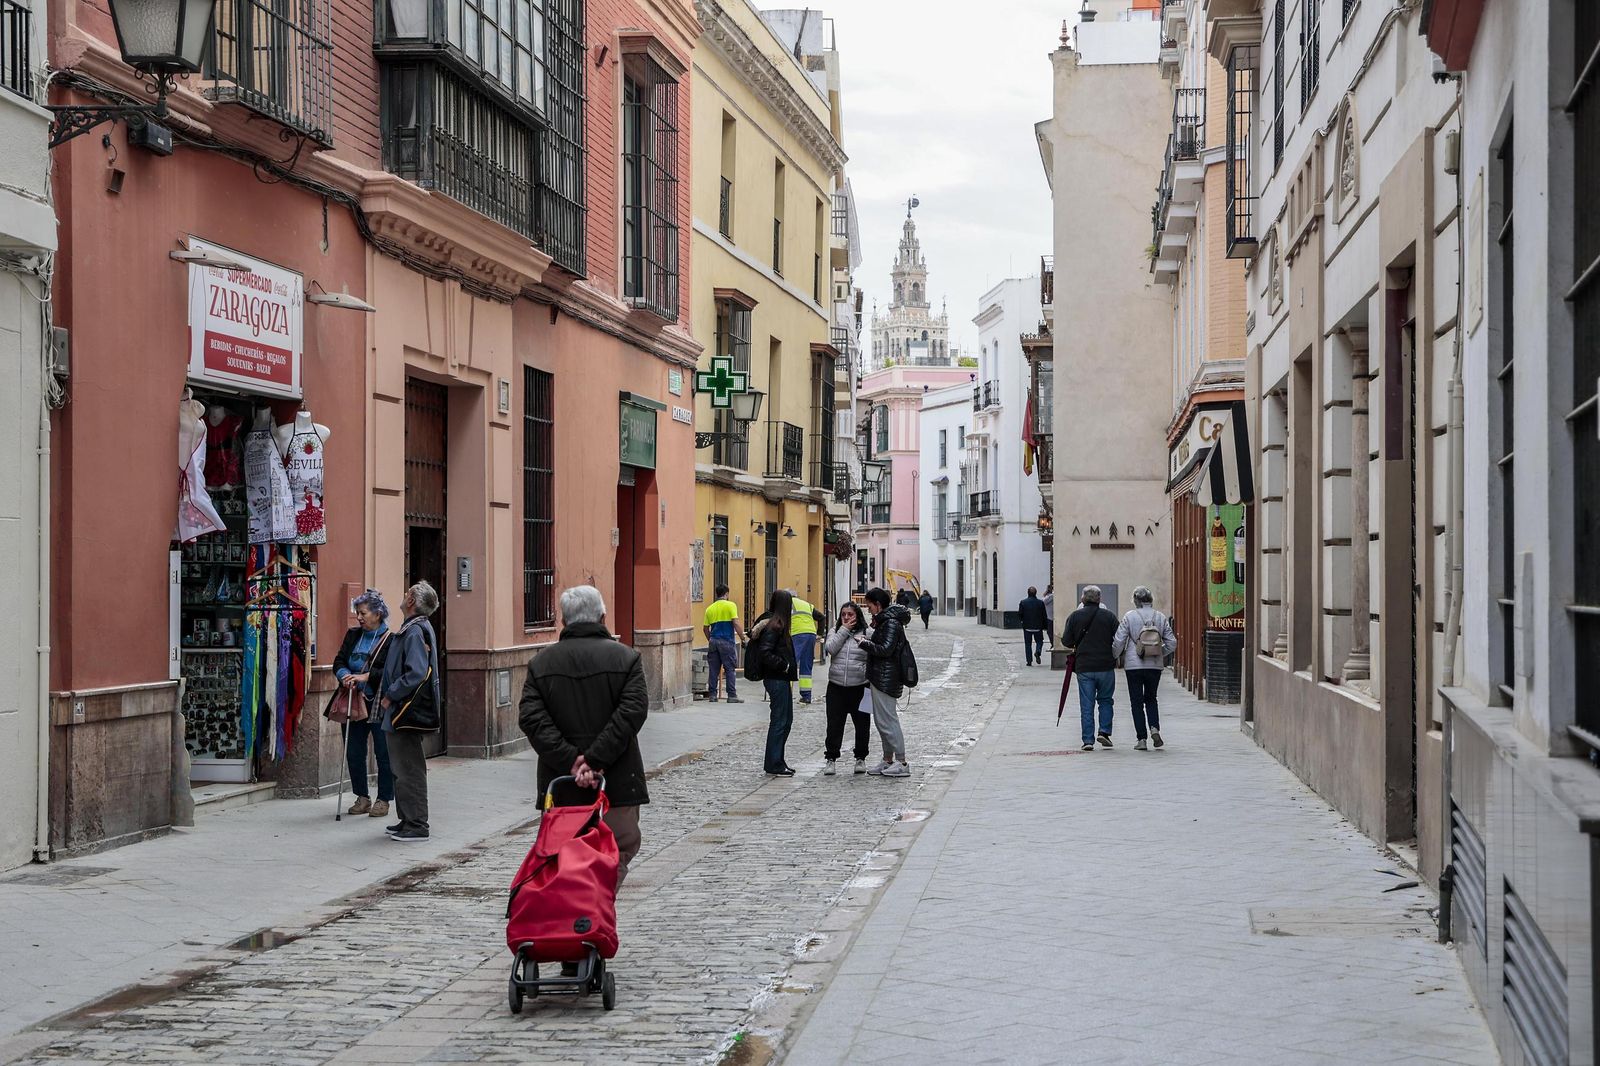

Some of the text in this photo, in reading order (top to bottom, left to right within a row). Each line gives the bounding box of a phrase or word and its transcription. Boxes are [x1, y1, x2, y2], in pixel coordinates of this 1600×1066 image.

[227, 269, 272, 294] SUPERMERCADO
[209, 284, 289, 337] ZARAGOZA
[210, 339, 287, 366] BEBIDAS CHUCHERÍAS REGALOS
[226, 357, 271, 375] SOUVENIRS BAZAR
